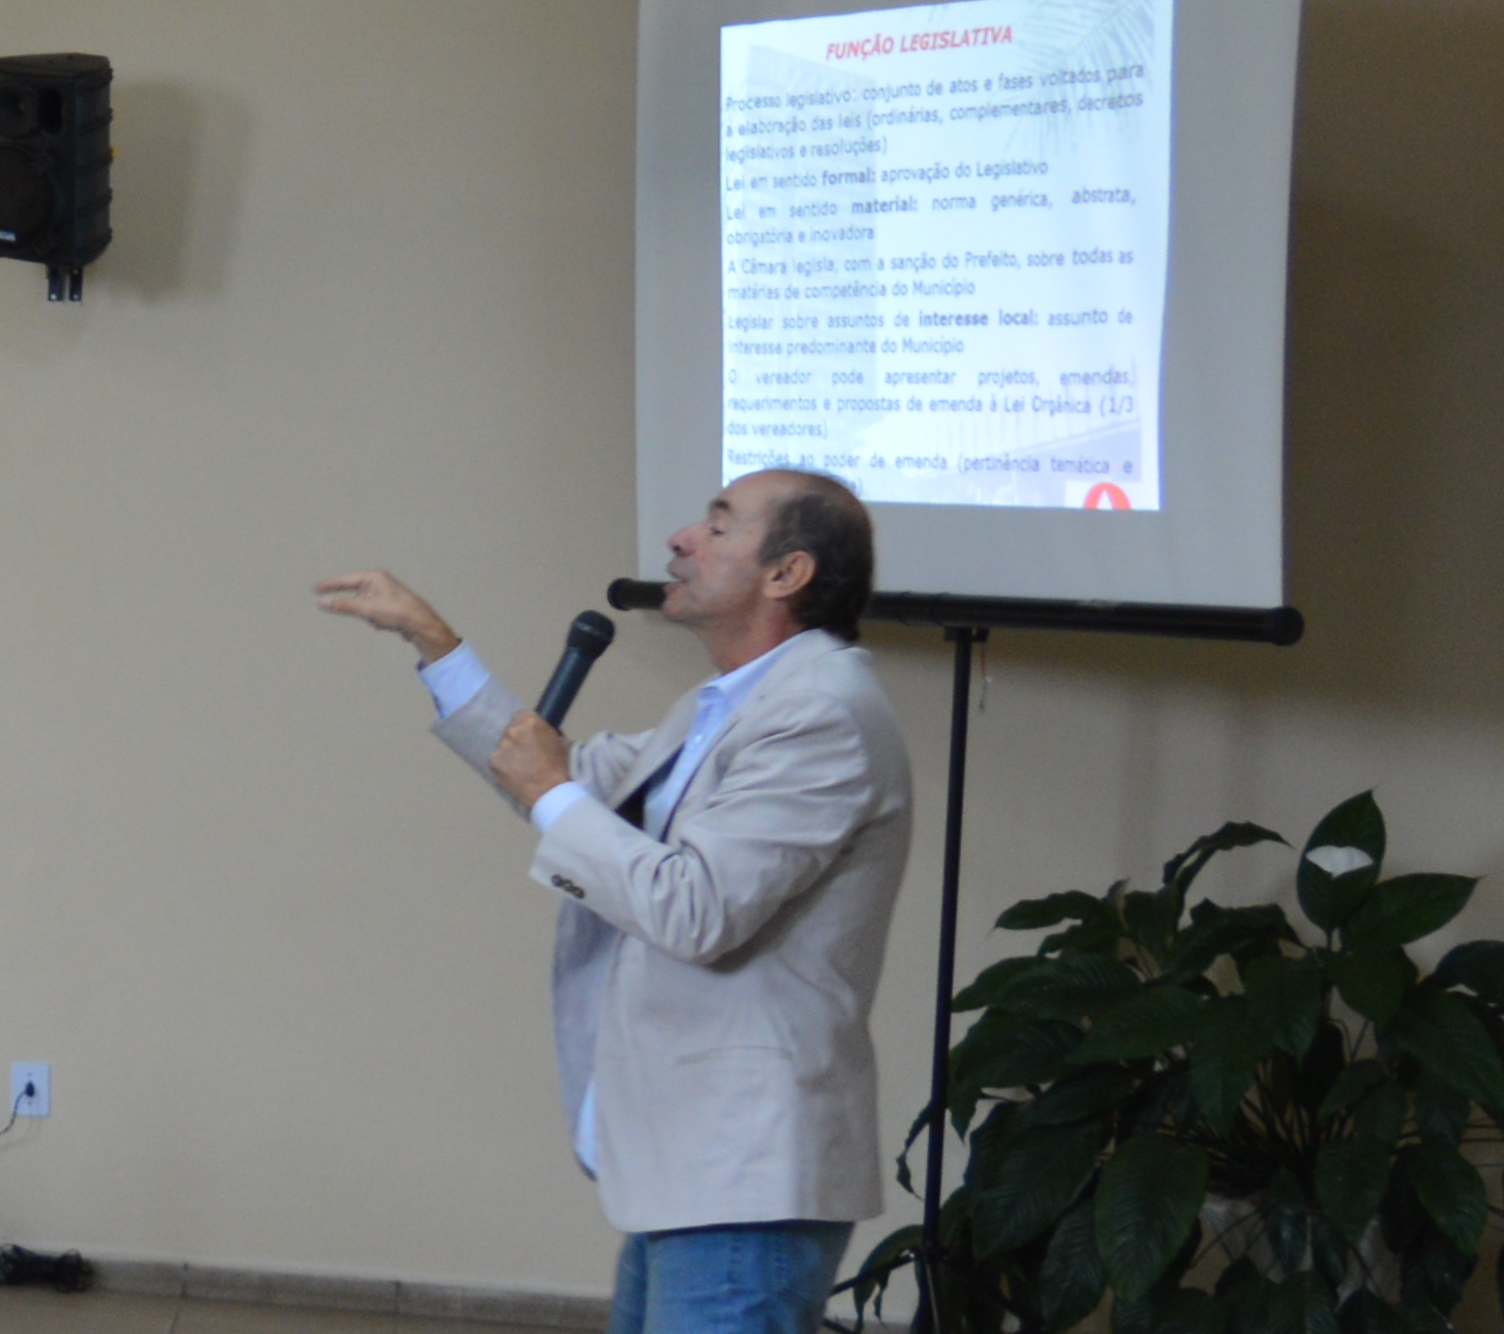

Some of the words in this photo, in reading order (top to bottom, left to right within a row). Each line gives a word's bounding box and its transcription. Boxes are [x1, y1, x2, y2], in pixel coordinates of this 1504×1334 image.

[826, 33, 894, 61] FUNÇÃO
[900, 25, 1013, 53] LEGISLATIVA
[725, 94, 781, 112] Processo
[863, 83, 921, 102] conjunto
[926, 80, 943, 96] de
[949, 77, 977, 94] atos
[998, 73, 1032, 90] fases
[1107, 64, 1144, 83] para
[811, 116, 832, 131] das
[839, 114, 861, 129] leis
[950, 98, 1071, 122] complementares,
[726, 144, 794, 164] legislativos
[811, 137, 887, 156] resoluções)
[726, 177, 745, 191] Lei
[751, 177, 768, 189] em
[773, 174, 816, 188] sentido
[822, 167, 876, 185] formal:
[882, 162, 949, 183] aprovação
[955, 162, 971, 178] do
[977, 159, 1048, 180] Legislativo
[727, 205, 745, 220] Lei
[759, 206, 775, 218] em
[789, 202, 837, 218] sentido
[852, 196, 917, 214] material:
[932, 196, 975, 210] norma
[810, 226, 874, 242] inovadora
[845, 258, 870, 271] com
[891, 254, 936, 272] sanção
[942, 253, 958, 268] do
[966, 249, 1021, 268] Prefeito,
[1027, 250, 1064, 266] sobre
[1073, 246, 1112, 264] todas
[1119, 249, 1133, 264] as
[785, 285, 799, 299] de
[804, 281, 887, 299] competência
[892, 282, 908, 296] do
[728, 315, 773, 331] Legislar
[783, 315, 818, 329] sobre
[828, 314, 884, 328] assuntos
[894, 312, 910, 327] de
[919, 311, 988, 326] interesse
[999, 309, 1039, 326] local:
[1047, 308, 1108, 326] assunto
[1118, 308, 1132, 324] de
[728, 341, 782, 355] interesse
[787, 339, 876, 357] predominante
[881, 338, 897, 354] do
[756, 369, 812, 384] vereador
[832, 368, 863, 387] pode
[885, 370, 956, 387] apresentar
[978, 369, 1039, 388] projetos,
[728, 396, 816, 412] requerimentos
[838, 397, 900, 412] propostas
[907, 396, 922, 411] de
[930, 396, 982, 412] emenda
[1004, 396, 1024, 412] Lei
[1100, 396, 1134, 416] (1/3
[727, 421, 747, 436] dos
[752, 420, 828, 438] vereadores)
[799, 454, 814, 467] ao
[824, 452, 860, 468] poder
[870, 453, 884, 468] de
[895, 454, 946, 470] emenda
